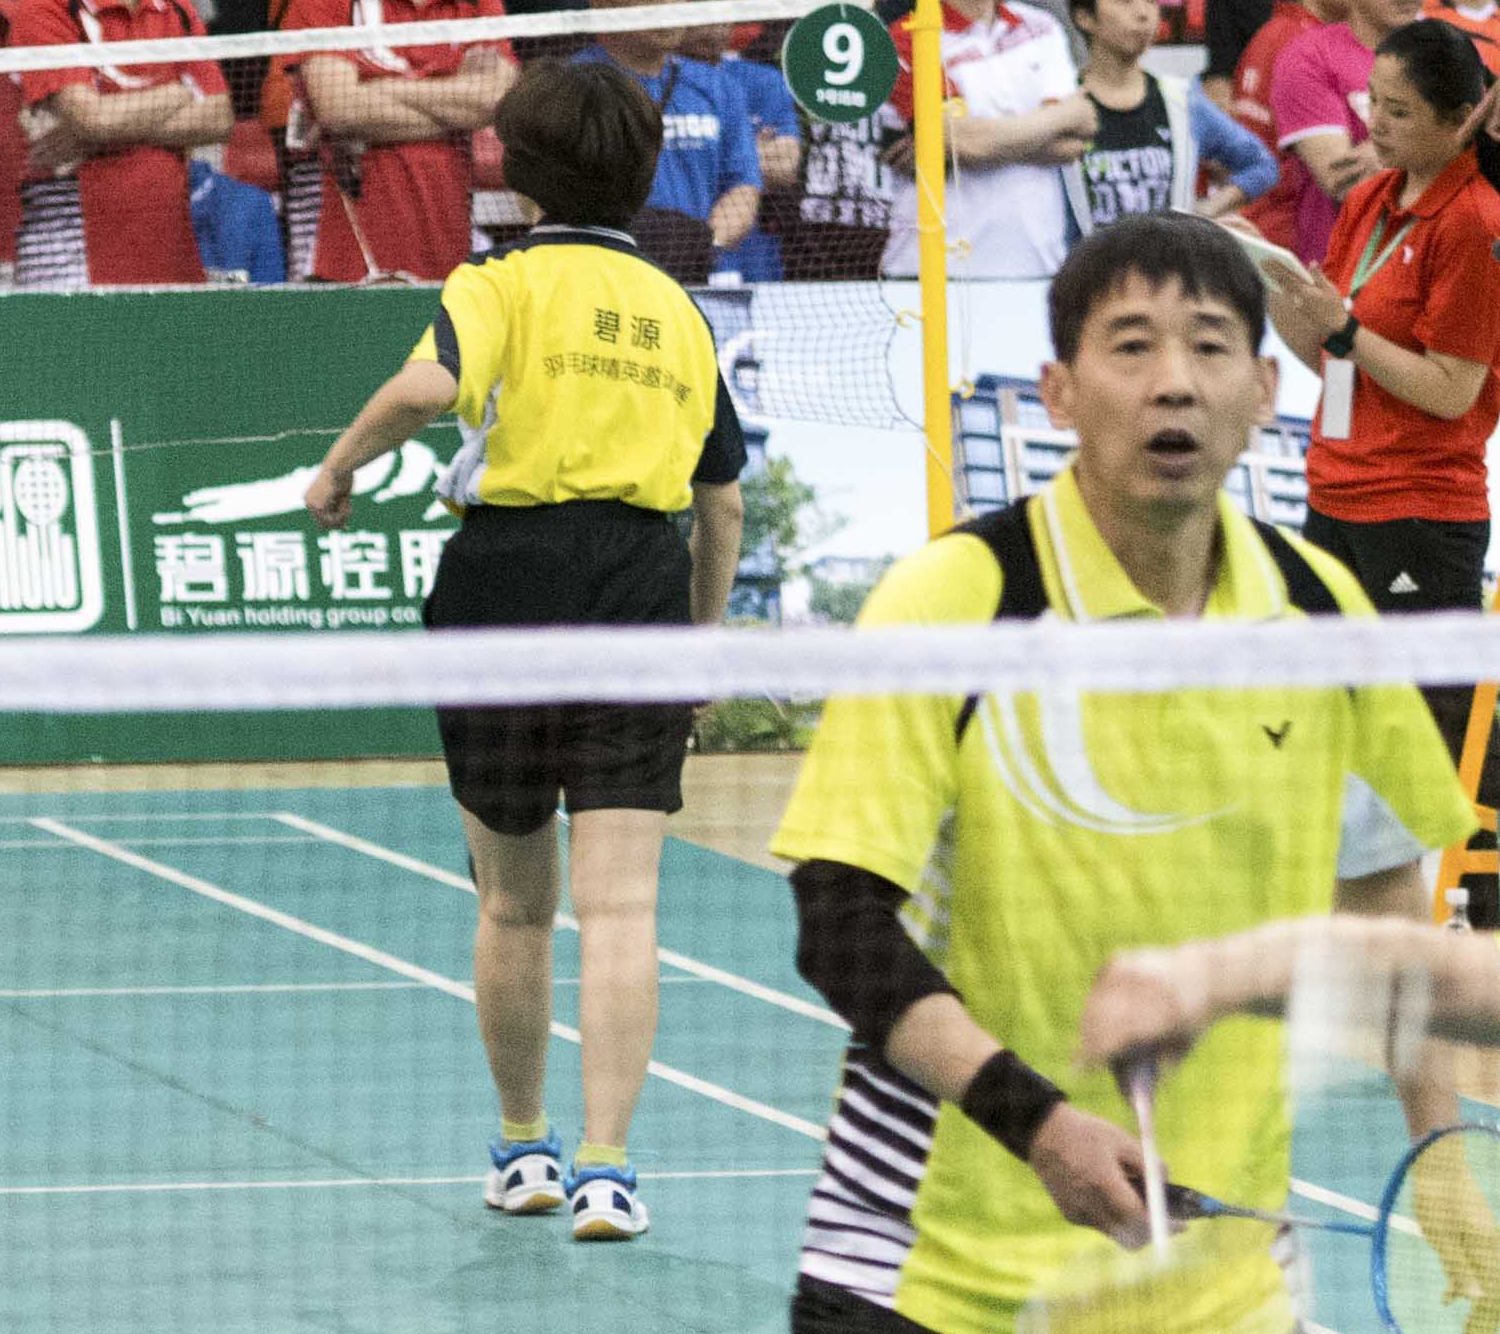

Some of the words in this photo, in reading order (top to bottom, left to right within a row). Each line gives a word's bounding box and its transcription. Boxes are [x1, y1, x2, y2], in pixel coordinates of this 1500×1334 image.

[822, 22, 864, 85] 9
[161, 608, 182, 626] Bi
[185, 609, 239, 625] Yuan
[245, 607, 322, 628] holding
[327, 608, 388, 628] group
